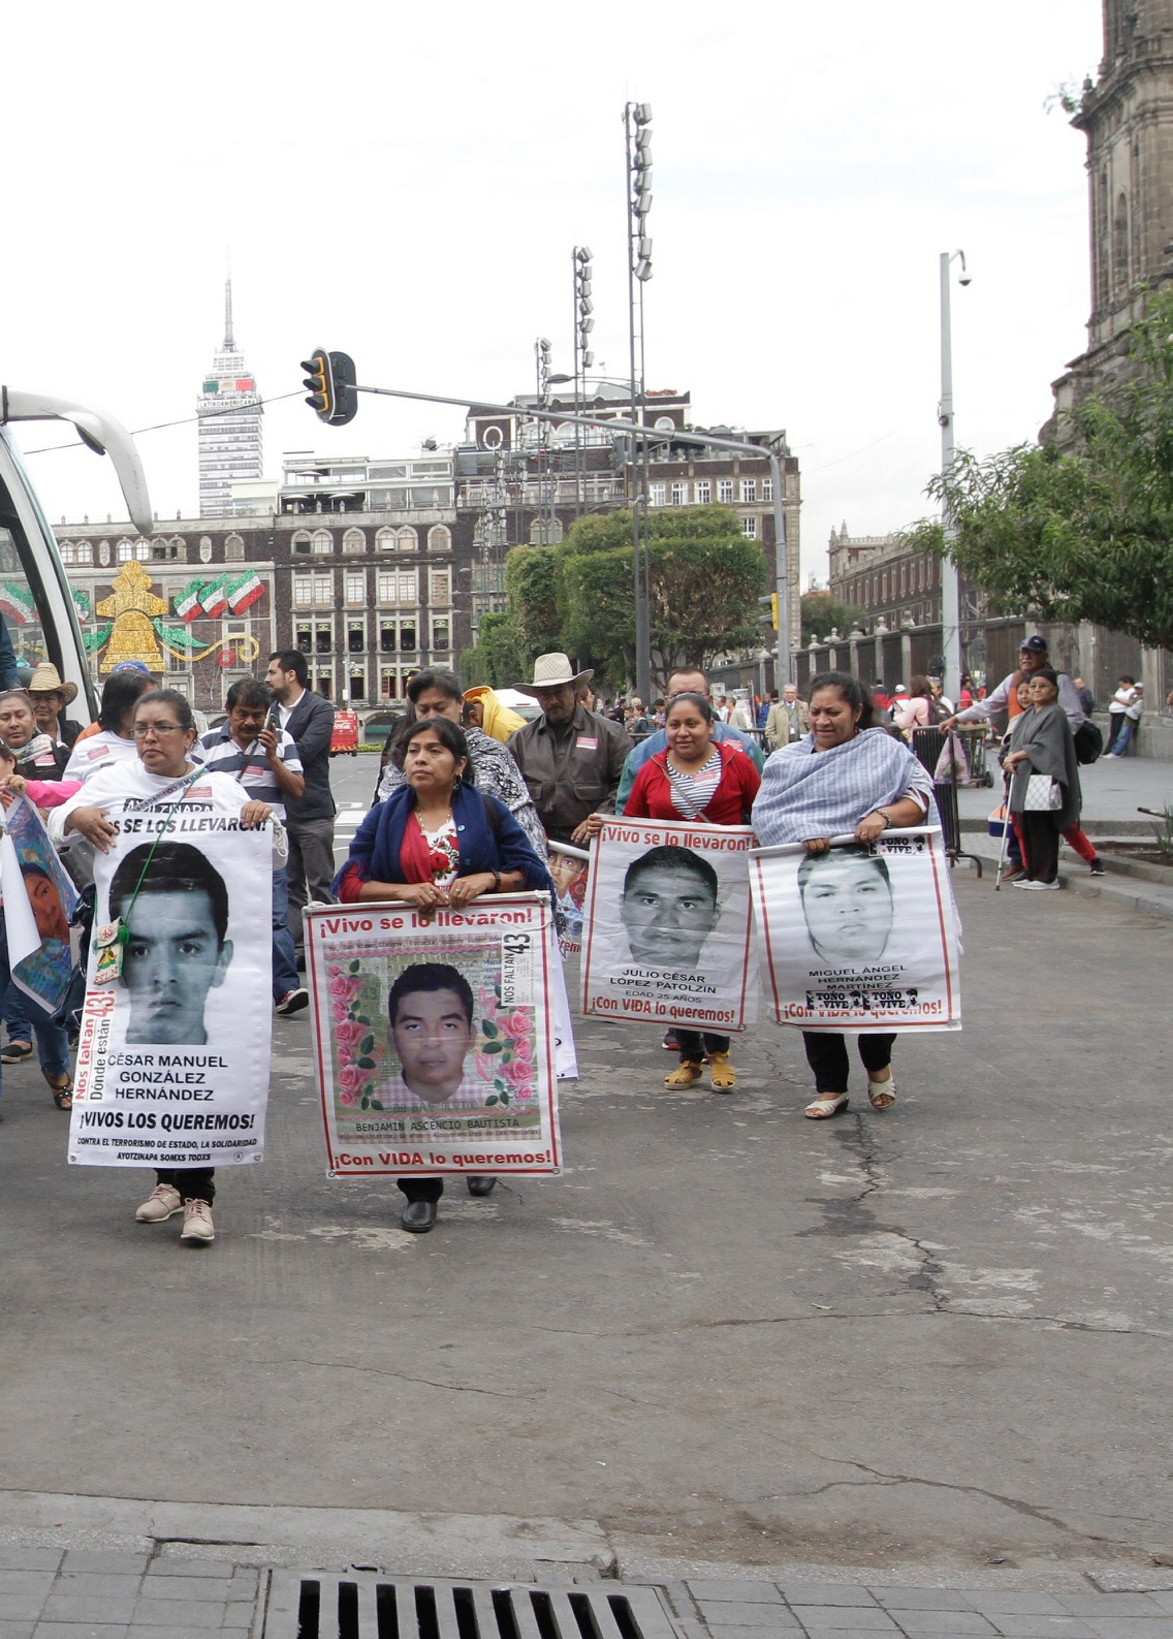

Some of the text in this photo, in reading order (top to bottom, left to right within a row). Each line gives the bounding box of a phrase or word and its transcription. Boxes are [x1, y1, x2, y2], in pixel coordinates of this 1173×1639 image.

[123, 819, 143, 834] SE
[146, 819, 177, 834] LOS
[602, 827, 750, 850] ¡Vivo se lo llevaron!
[886, 846, 912, 854] VIVE
[320, 917, 373, 938] ¡Vivo
[380, 917, 404, 930] se
[438, 908, 532, 927] llevaron!
[503, 934, 530, 954] 43
[504, 953, 515, 984] FALTAN
[809, 965, 908, 977] MIGUEL ÁNGEL
[610, 977, 651, 988] LÓPEZ
[622, 969, 705, 983] JULIO CÉSAR
[818, 974, 900, 984] HERNÁNDEZ
[826, 982, 893, 990] MARTÍNEZ
[504, 984, 515, 1004] NOS
[626, 990, 654, 998] EDAD
[673, 994, 702, 1004] AÑOS
[816, 990, 846, 1000] TOÑO
[872, 990, 902, 1000] TOÑO
[592, 996, 735, 1022] ¡Con VIDA lo queremos!
[823, 1000, 849, 1009] VIVE
[879, 1000, 906, 1009] VIVE
[76, 990, 116, 1100] Nos faltan 43!
[90, 1018, 111, 1100] Dónde están
[108, 1052, 228, 1068] CÉSAR MANUEL
[120, 1070, 206, 1084] GONZÁLEZ
[115, 1087, 214, 1101] HERNÁNDEZ
[80, 1112, 255, 1132] ¡VIVOS LOS QUEREMOS!
[410, 1120, 462, 1131] ASCENCIO
[468, 1118, 520, 1128] BAUTISTA
[77, 1138, 257, 1150] CONTRA EL TERRORISMO DE ESTADO, LA SOLIDARIDAD
[117, 1152, 158, 1161] AYOTZINAPA
[334, 1150, 551, 1168] ¡Con VIDA lo queremos!
